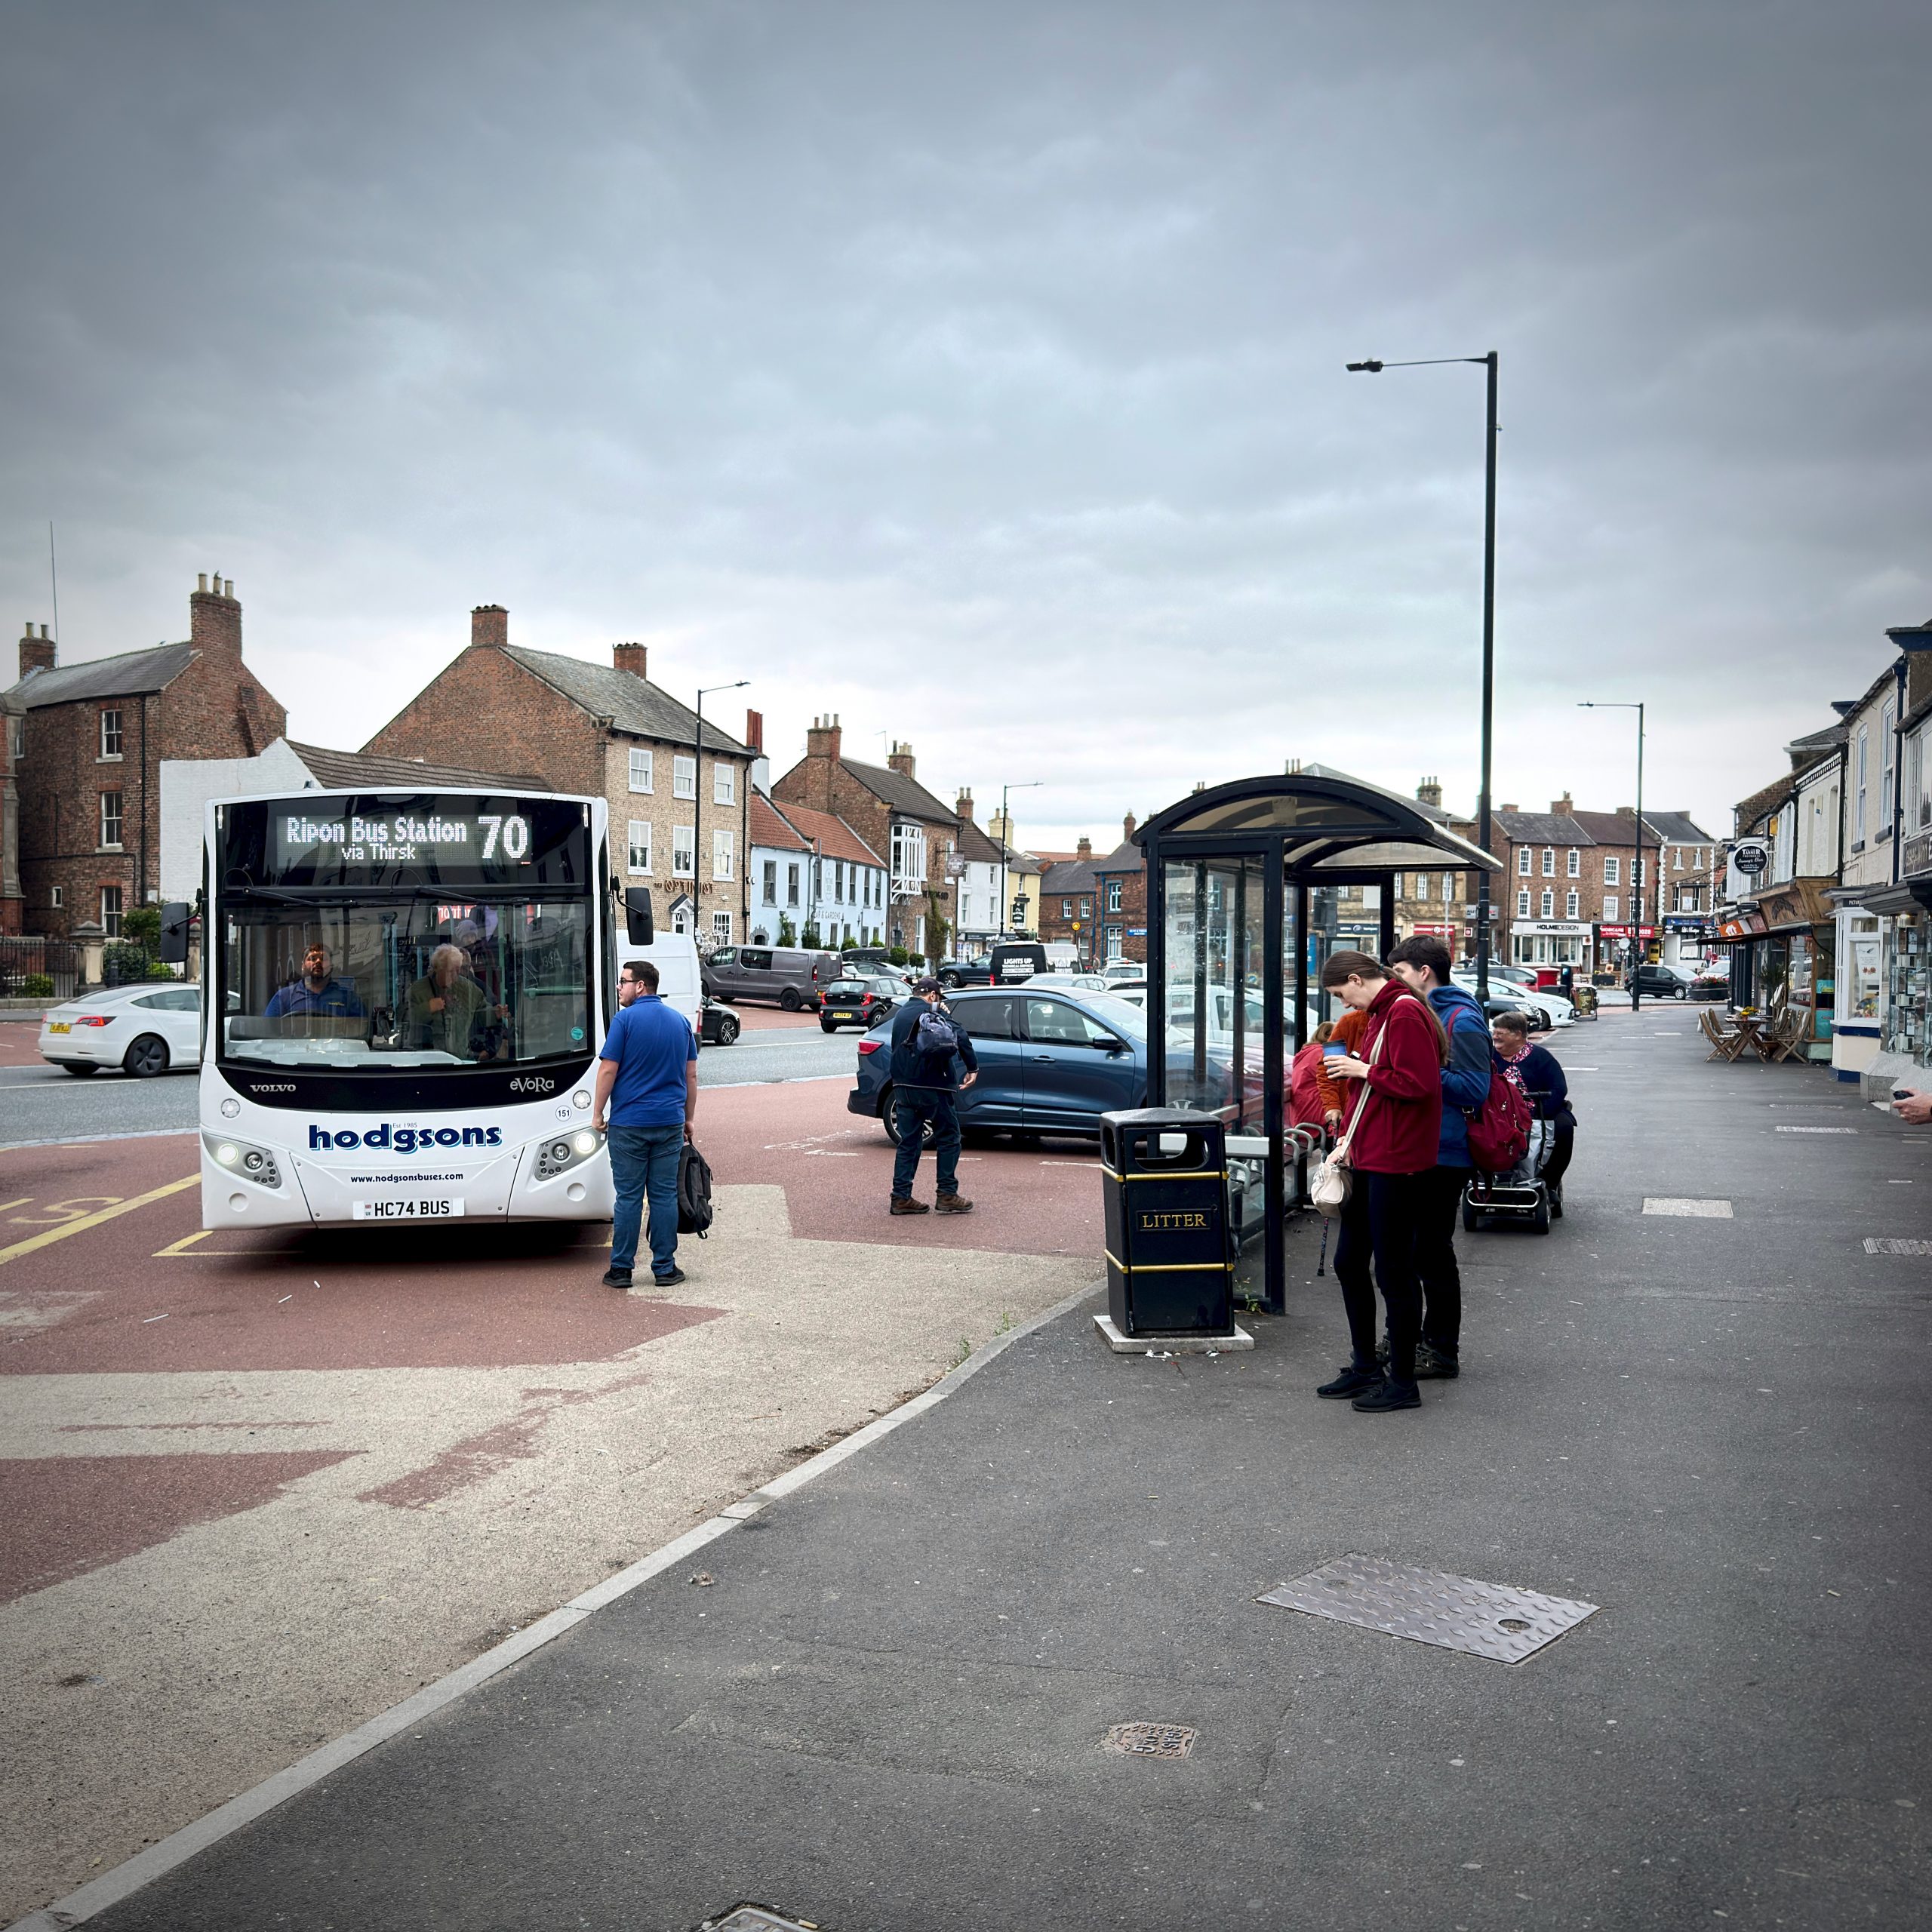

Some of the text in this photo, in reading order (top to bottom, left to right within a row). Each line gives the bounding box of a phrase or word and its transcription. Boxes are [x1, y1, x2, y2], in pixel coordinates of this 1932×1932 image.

[287, 817, 466, 843] Ripon Bus Station
[478, 816, 528, 859] 70
[341, 843, 416, 860] via Thirsk
[250, 1084, 296, 1093] VOLVO
[557, 1109, 571, 1118] 151
[309, 1123, 502, 1154] hodgsons
[350, 1172, 463, 1183] www.hodgsonsbuses.com
[375, 1201, 450, 1217] HC74 BUS
[1142, 1214, 1207, 1228] LITTER
